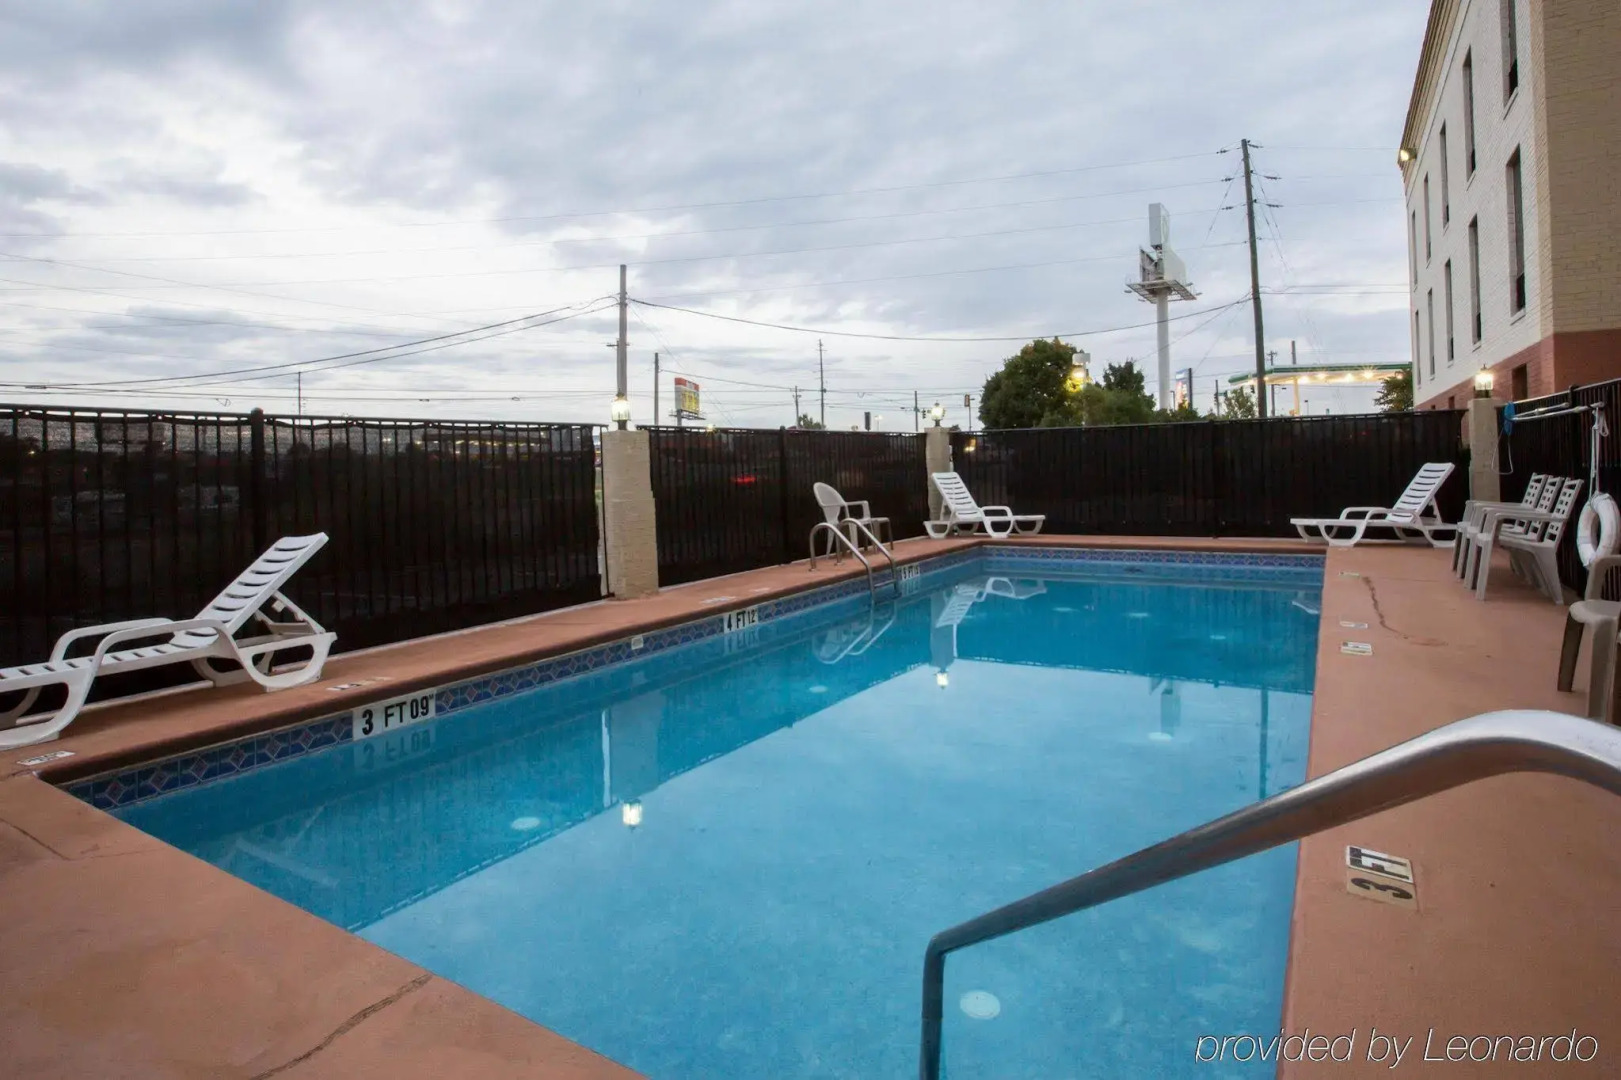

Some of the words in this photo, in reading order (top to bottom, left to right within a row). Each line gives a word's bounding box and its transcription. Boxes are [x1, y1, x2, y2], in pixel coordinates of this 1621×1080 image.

[727, 614, 732, 631] 4
[736, 610, 746, 629] FT
[362, 709, 374, 735] 3
[384, 701, 407, 728] FT
[1349, 846, 1410, 880] FT
[1350, 877, 1413, 900] 3
